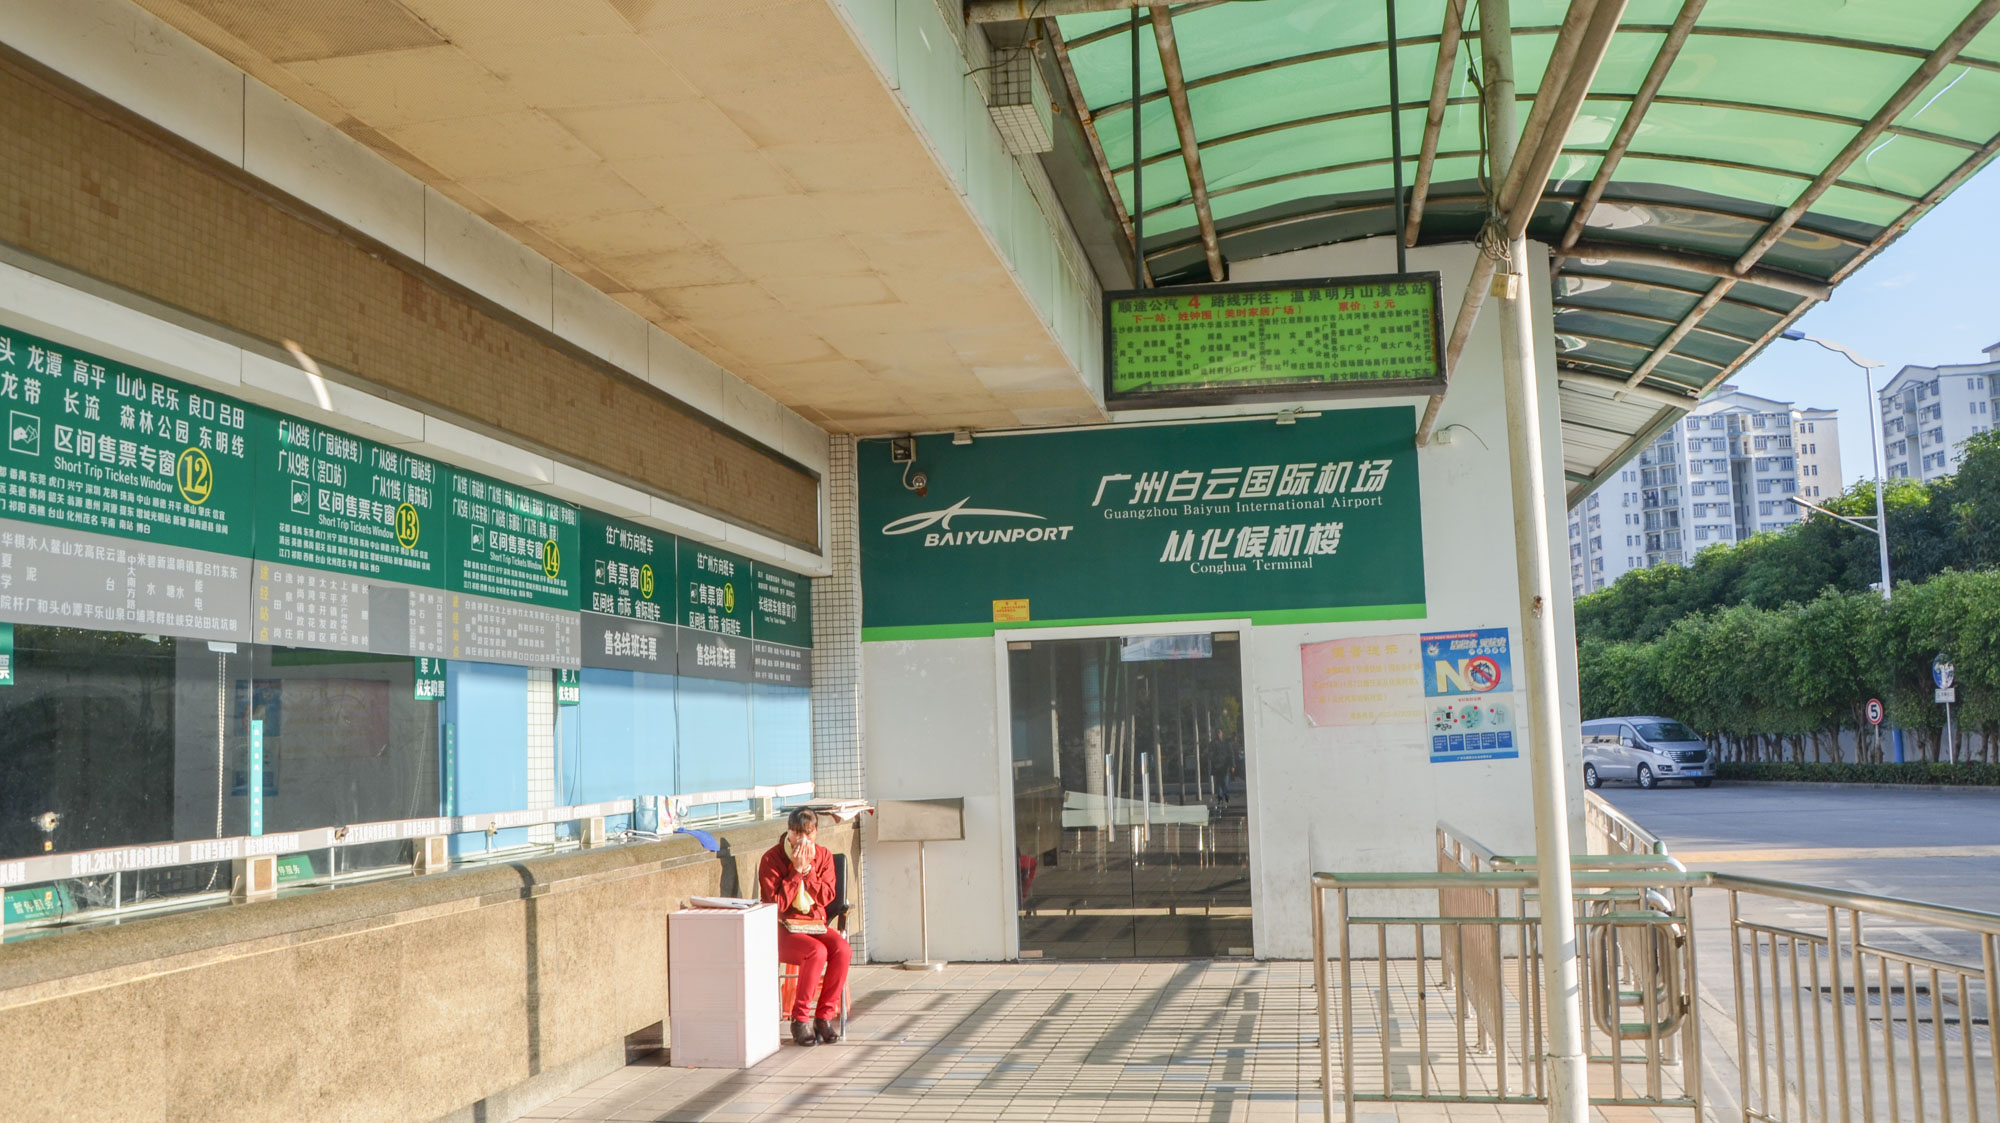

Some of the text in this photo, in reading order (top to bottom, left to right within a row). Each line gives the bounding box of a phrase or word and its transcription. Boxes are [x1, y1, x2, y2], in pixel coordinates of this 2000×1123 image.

[1188, 293, 1200, 309] 4
[1291, 282, 1427, 303] 温泉明月山溪总站
[1373, 301, 1380, 309] 3
[1385, 299, 1395, 309] 元
[27, 345, 62, 378] 龙潭
[74, 359, 106, 390] 高平
[116, 372, 146, 401] 山心
[152, 382, 179, 411] 民乐
[189, 394, 214, 420] 良口
[220, 403, 244, 429] 吕田
[64, 388, 100, 421] 长流
[120, 405, 189, 444] 森林公园
[199, 426, 244, 458] 东明线
[54, 424, 208, 495] 区间售票专窗 12
[54, 456, 173, 493] Short Trip Tickets Window
[1092, 459, 1393, 506] 广州白云国际机场
[9, 484, 26, 497] 英德
[48, 491, 65, 505] 韶关
[29, 472, 46, 486] 东莞
[49, 476, 65, 489] 虎门
[67, 480, 83, 492] 兴宁
[103, 487, 118, 499] 龙岗
[137, 494, 150, 506] 中山
[168, 500, 182, 512] 开平
[48, 507, 64, 520] 台山
[319, 489, 416, 541] 区间售票专窗 13
[1104, 495, 1383, 519] Guangzhou Baiyun International Airport
[319, 514, 394, 539] Short Trip Tickets Window
[924, 525, 1074, 548] BAIYUNPORT
[489, 531, 558, 572] 区间售票专窗 14
[606, 525, 653, 555] 往广州方向班车
[1159, 522, 1344, 563] 从化候机楼
[490, 551, 542, 570] Short Trip Tickets Window
[697, 552, 734, 577] 往广州方向班车
[1189, 557, 1313, 576] Conghua Terminal
[607, 560, 652, 592] 售票窗 15
[593, 591, 661, 621] 区间线 市际 省际班车
[699, 584, 734, 607] 售票窗 16
[689, 611, 706, 630] 区间线
[604, 629, 657, 661] 售各线班车票
[696, 643, 736, 669] 售各线班车票
[417, 679, 445, 697] 优先购票
[1870, 704, 1879, 720] 5
[277, 864, 300, 876] 停服务
[13, 899, 54, 915] 暂停服务
